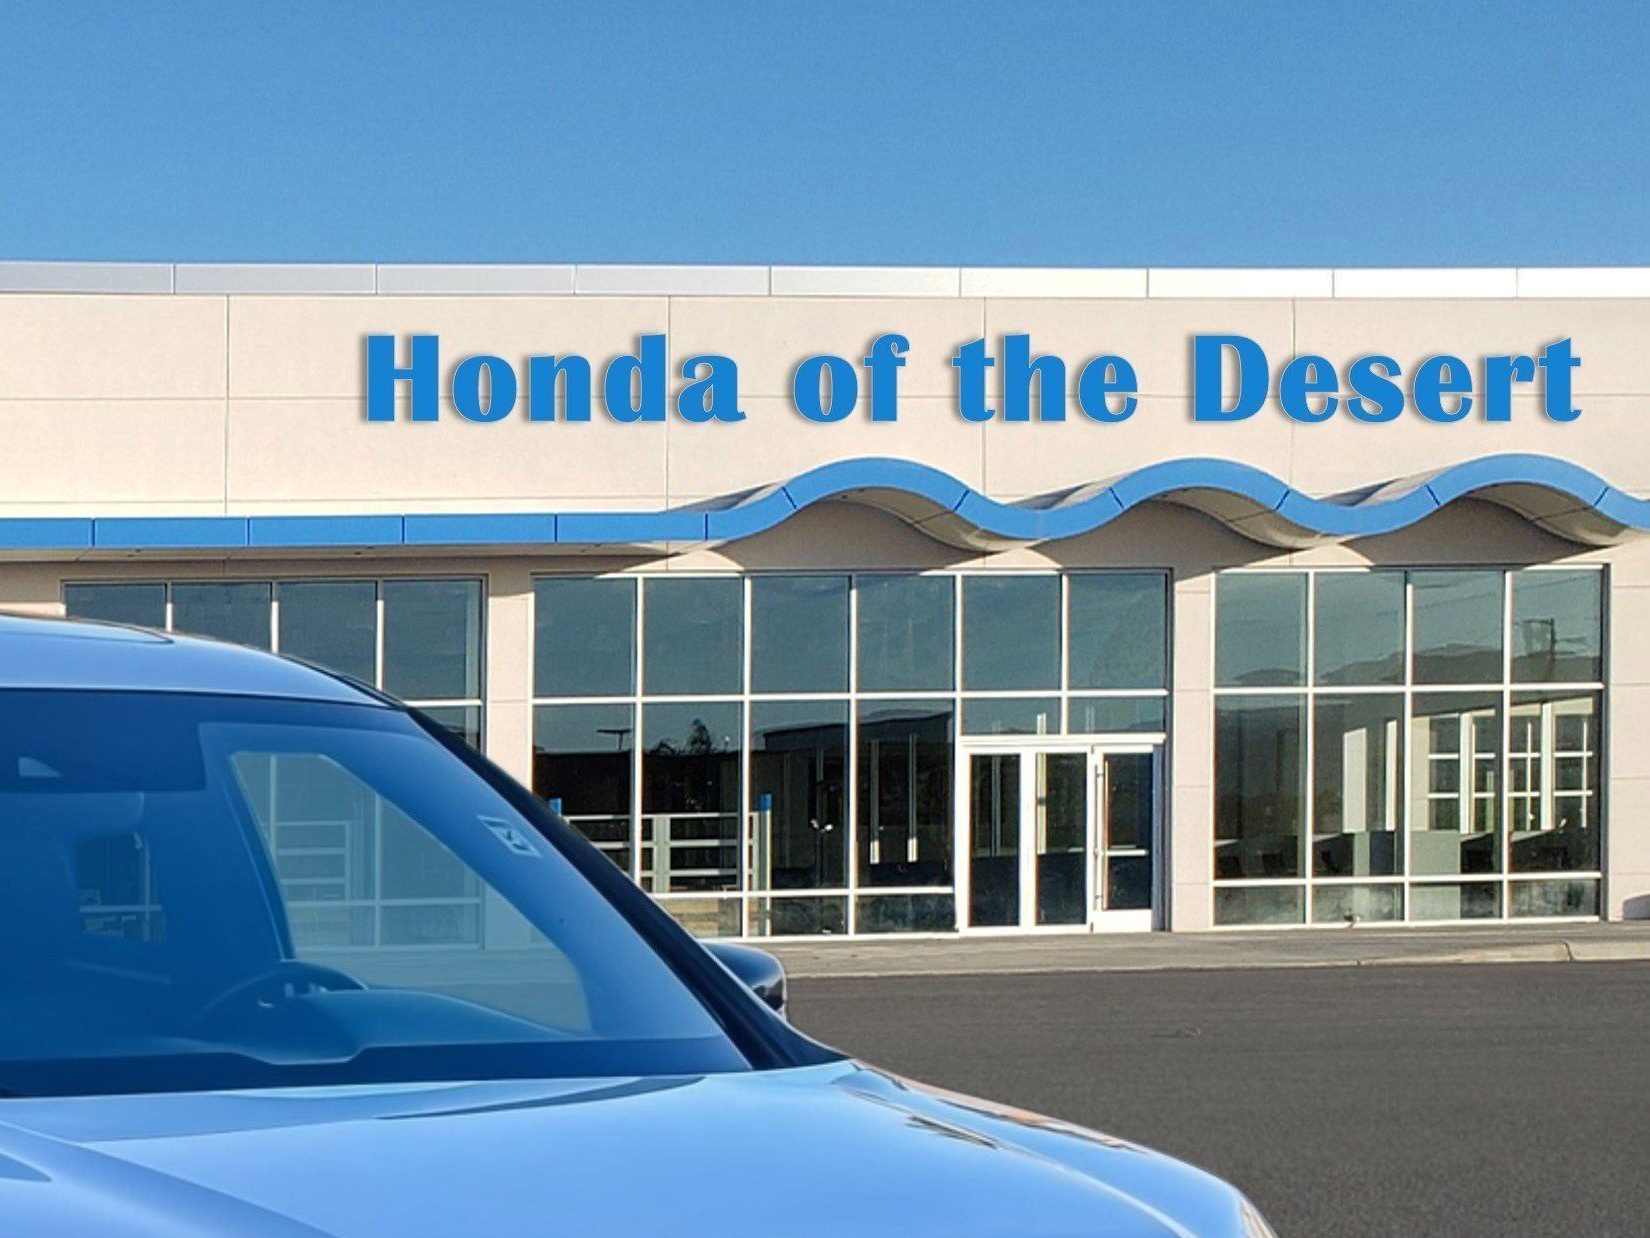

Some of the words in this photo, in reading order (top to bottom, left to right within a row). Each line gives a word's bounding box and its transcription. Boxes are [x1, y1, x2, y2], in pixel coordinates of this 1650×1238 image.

[366, 334, 747, 423] Honda
[794, 333, 910, 423] of
[951, 334, 1138, 423] the
[1193, 335, 1582, 423] Desert
